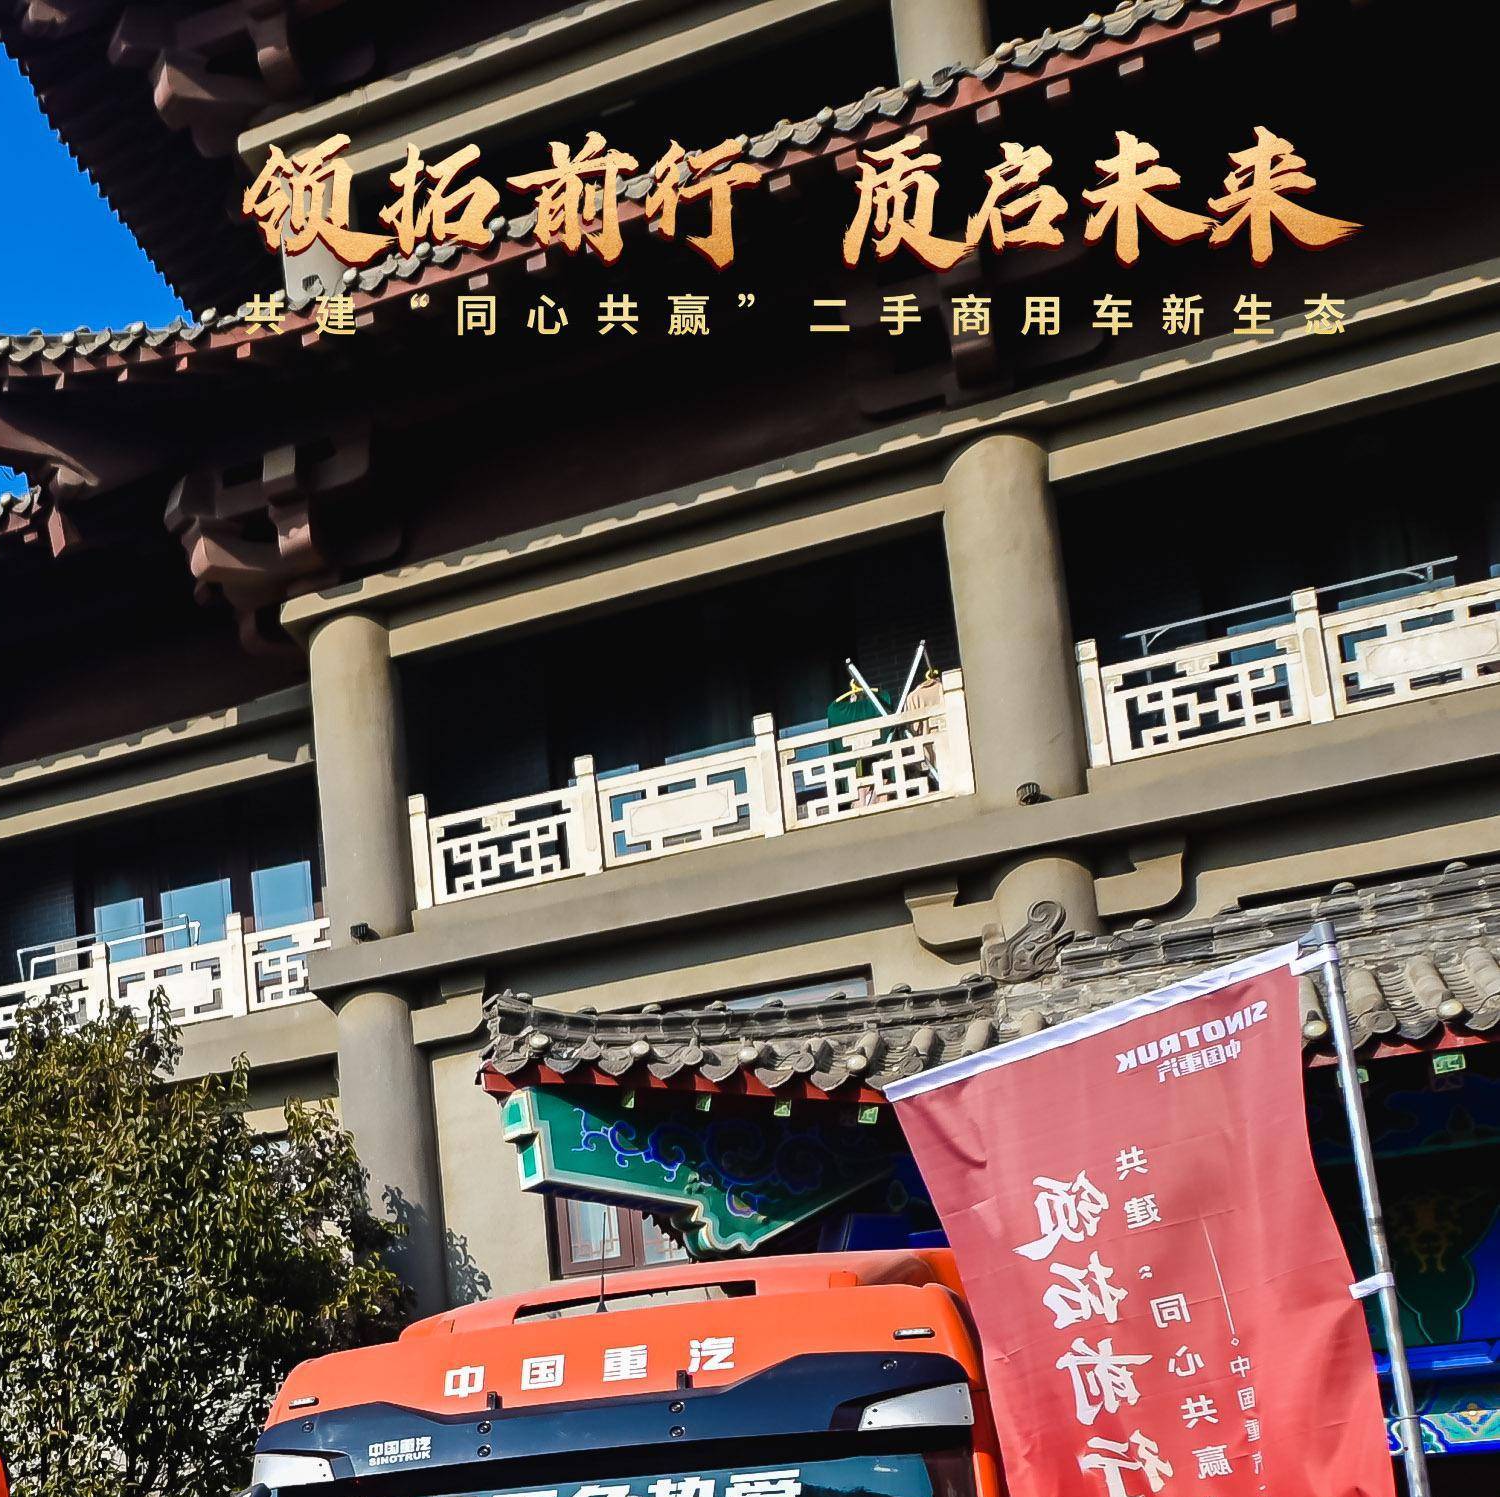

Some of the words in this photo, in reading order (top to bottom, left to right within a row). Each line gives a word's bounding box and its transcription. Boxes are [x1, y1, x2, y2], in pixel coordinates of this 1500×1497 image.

[443, 1336, 735, 1398] 中国重汽
[368, 1450, 431, 1467] SINOTRUK
